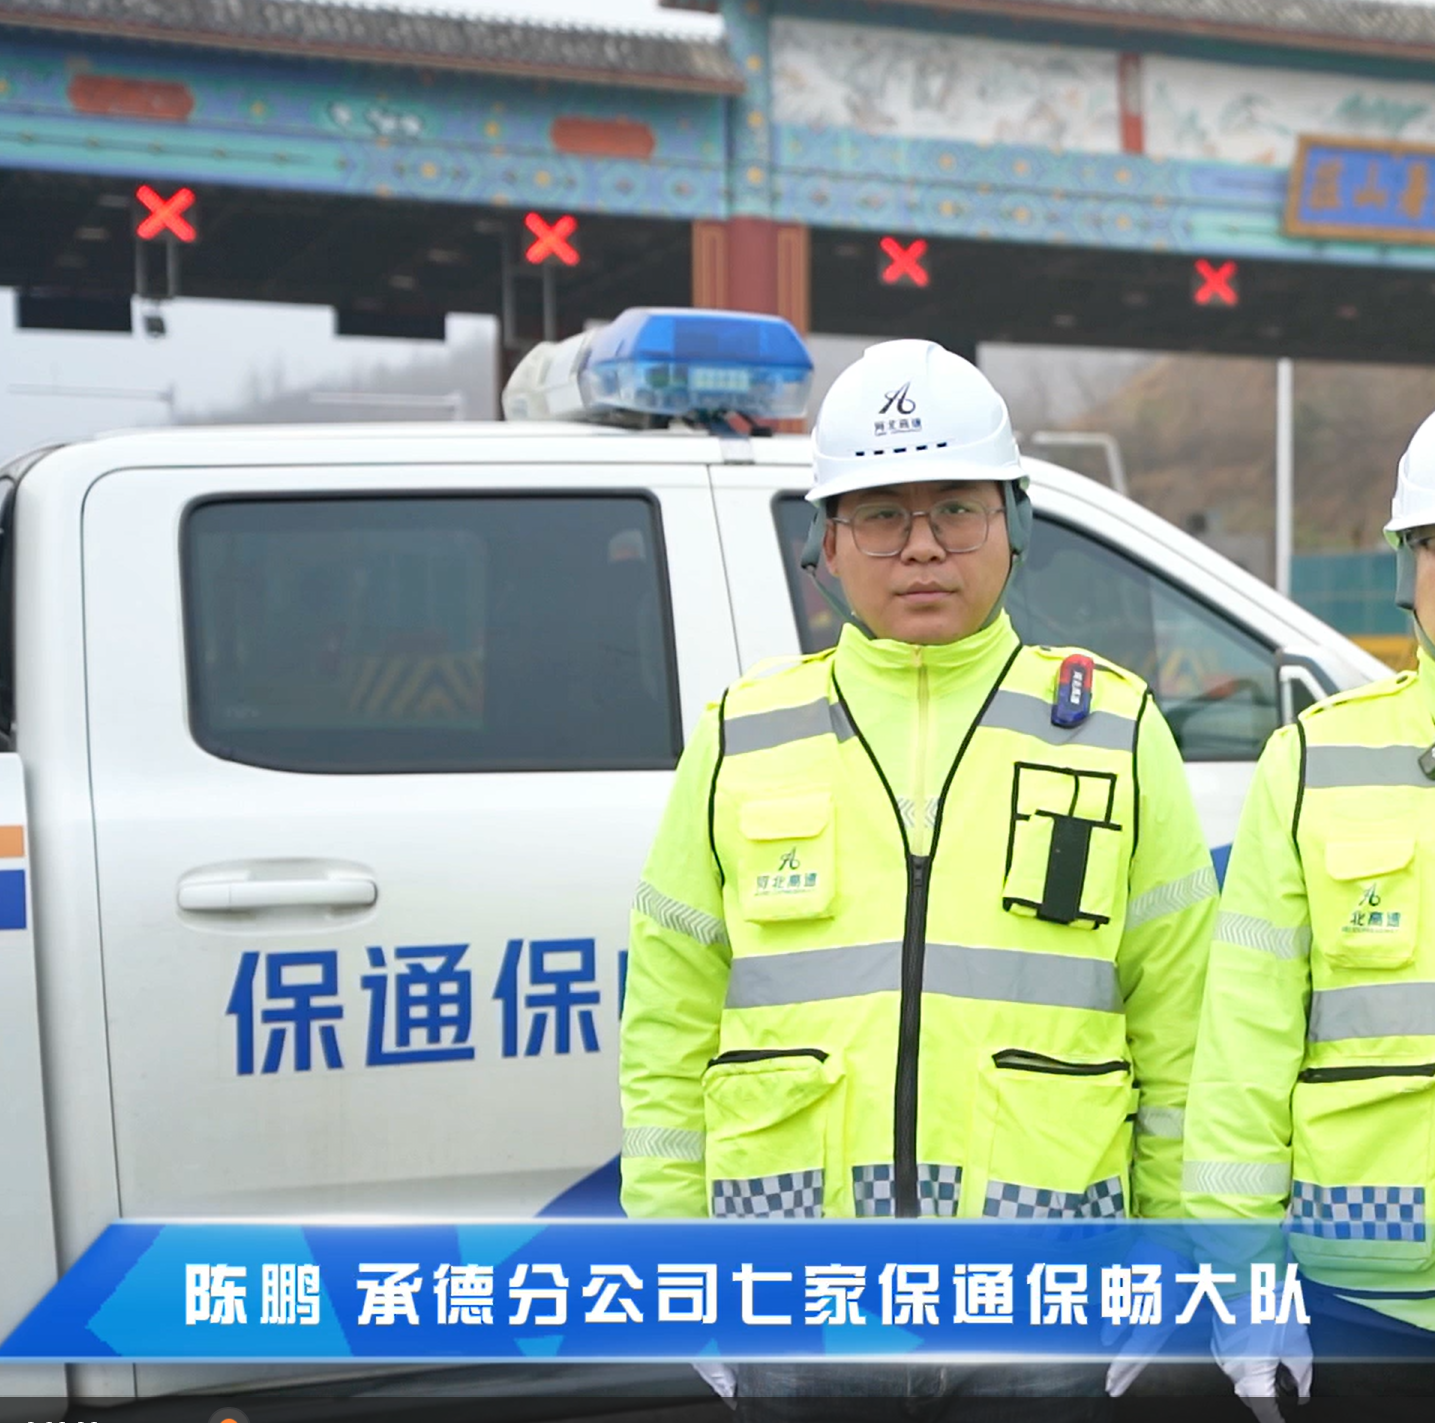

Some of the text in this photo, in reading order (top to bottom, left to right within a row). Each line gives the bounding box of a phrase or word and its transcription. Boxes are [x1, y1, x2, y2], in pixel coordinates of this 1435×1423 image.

[1350, 911, 1401, 927] 北高速
[225, 938, 630, 1076] 保通保
